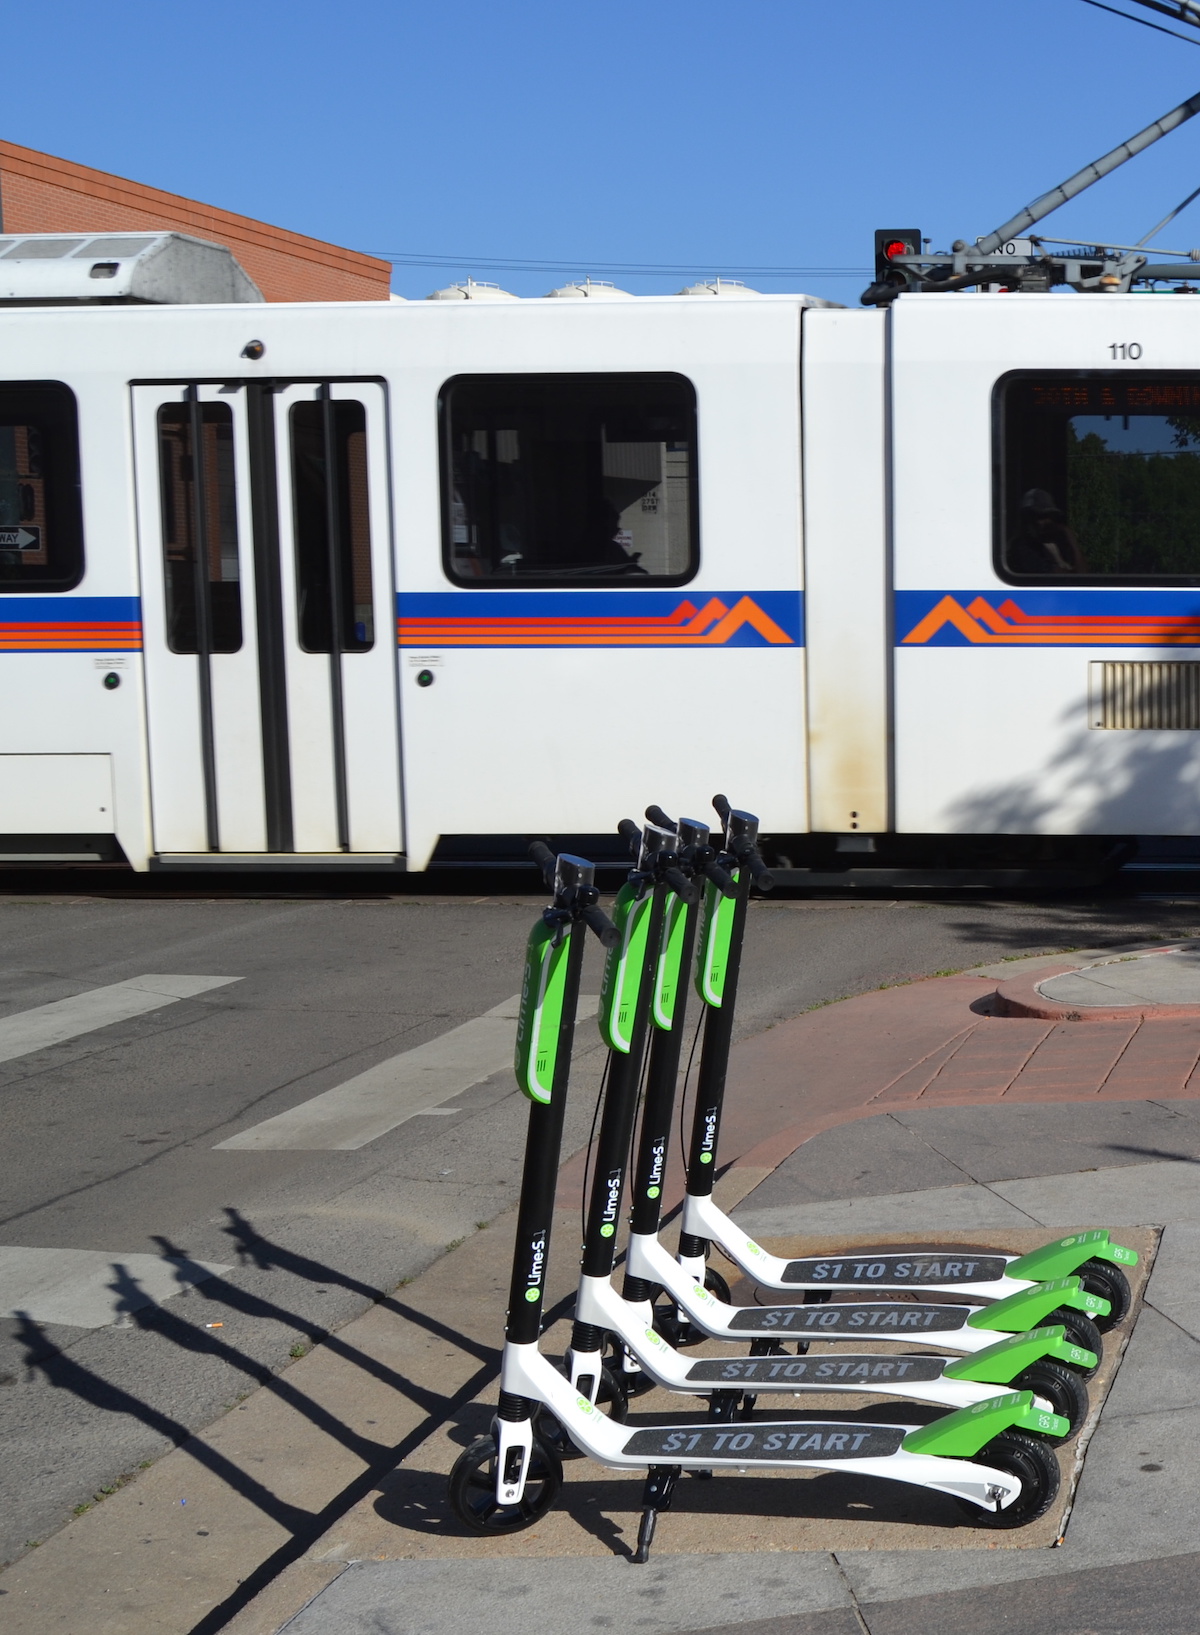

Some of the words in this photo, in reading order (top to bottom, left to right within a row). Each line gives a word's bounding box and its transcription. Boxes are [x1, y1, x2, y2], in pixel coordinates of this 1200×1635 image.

[1108, 342, 1143, 360] 110
[0, 533, 19, 543] WAY
[812, 1262, 843, 1280] $1
[853, 1263, 886, 1278] TO
[894, 1262, 980, 1278] START
[761, 1310, 796, 1327] $1
[805, 1311, 841, 1326] TO
[848, 1311, 940, 1326] START
[721, 1361, 756, 1379] $1
[768, 1362, 807, 1377] TO
[815, 1362, 914, 1377] START
[1038, 1413, 1051, 1429] GPS
[661, 1431, 703, 1452] $1
[712, 1432, 755, 1451] TO
[762, 1432, 871, 1451] START
